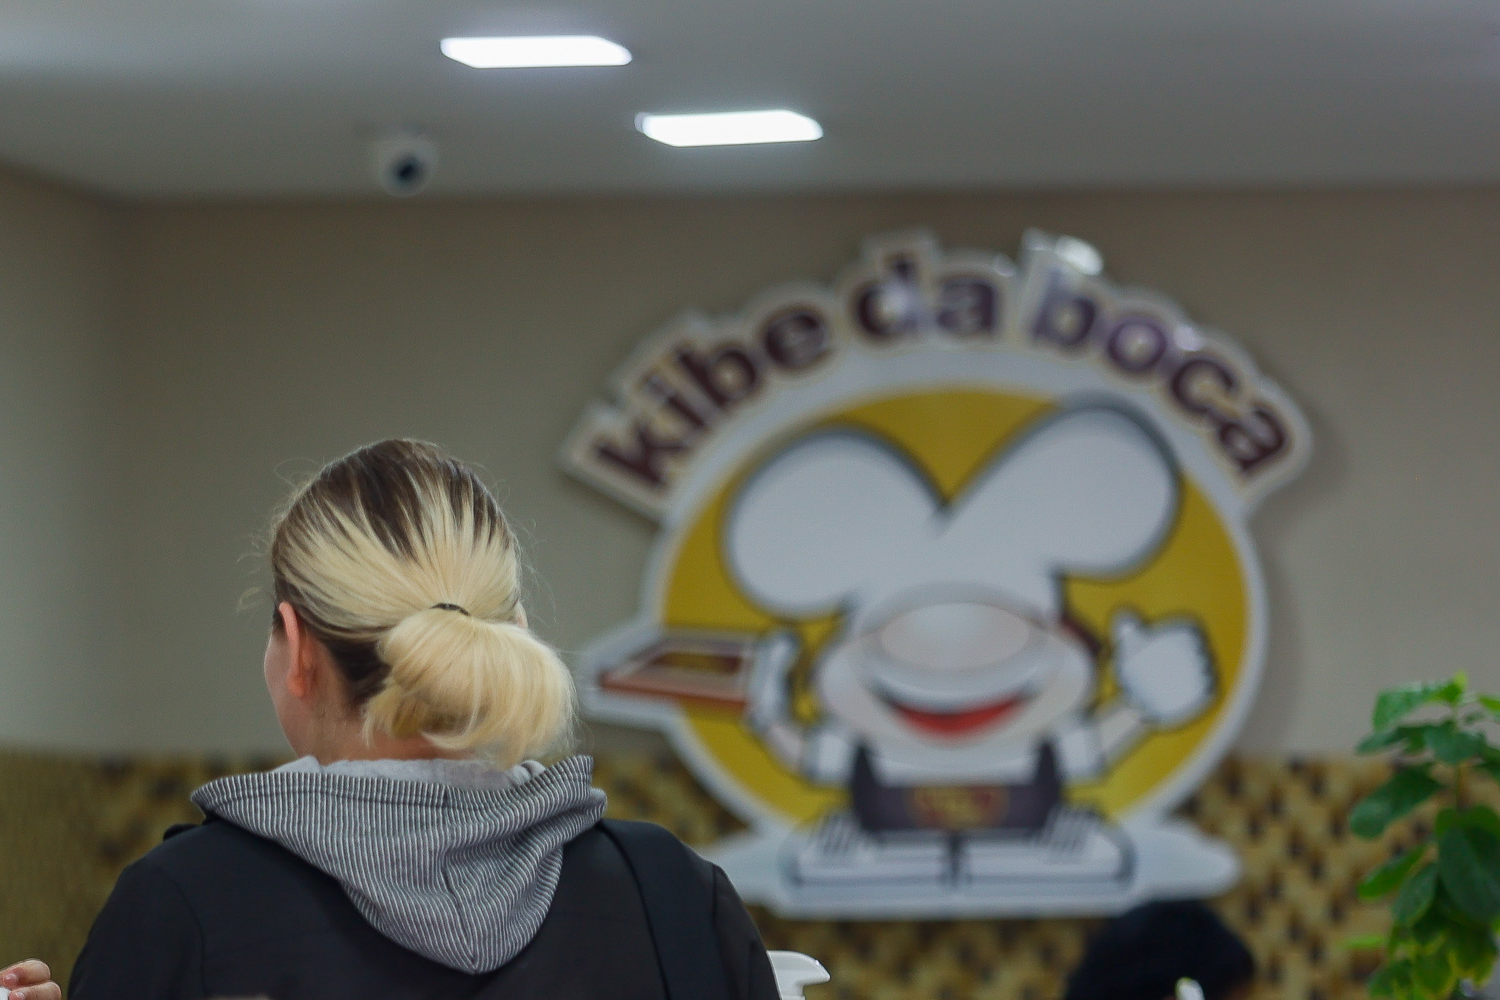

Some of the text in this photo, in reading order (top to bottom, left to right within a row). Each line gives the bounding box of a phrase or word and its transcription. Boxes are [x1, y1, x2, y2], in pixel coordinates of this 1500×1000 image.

[592, 254, 1293, 490] kibe da boca
